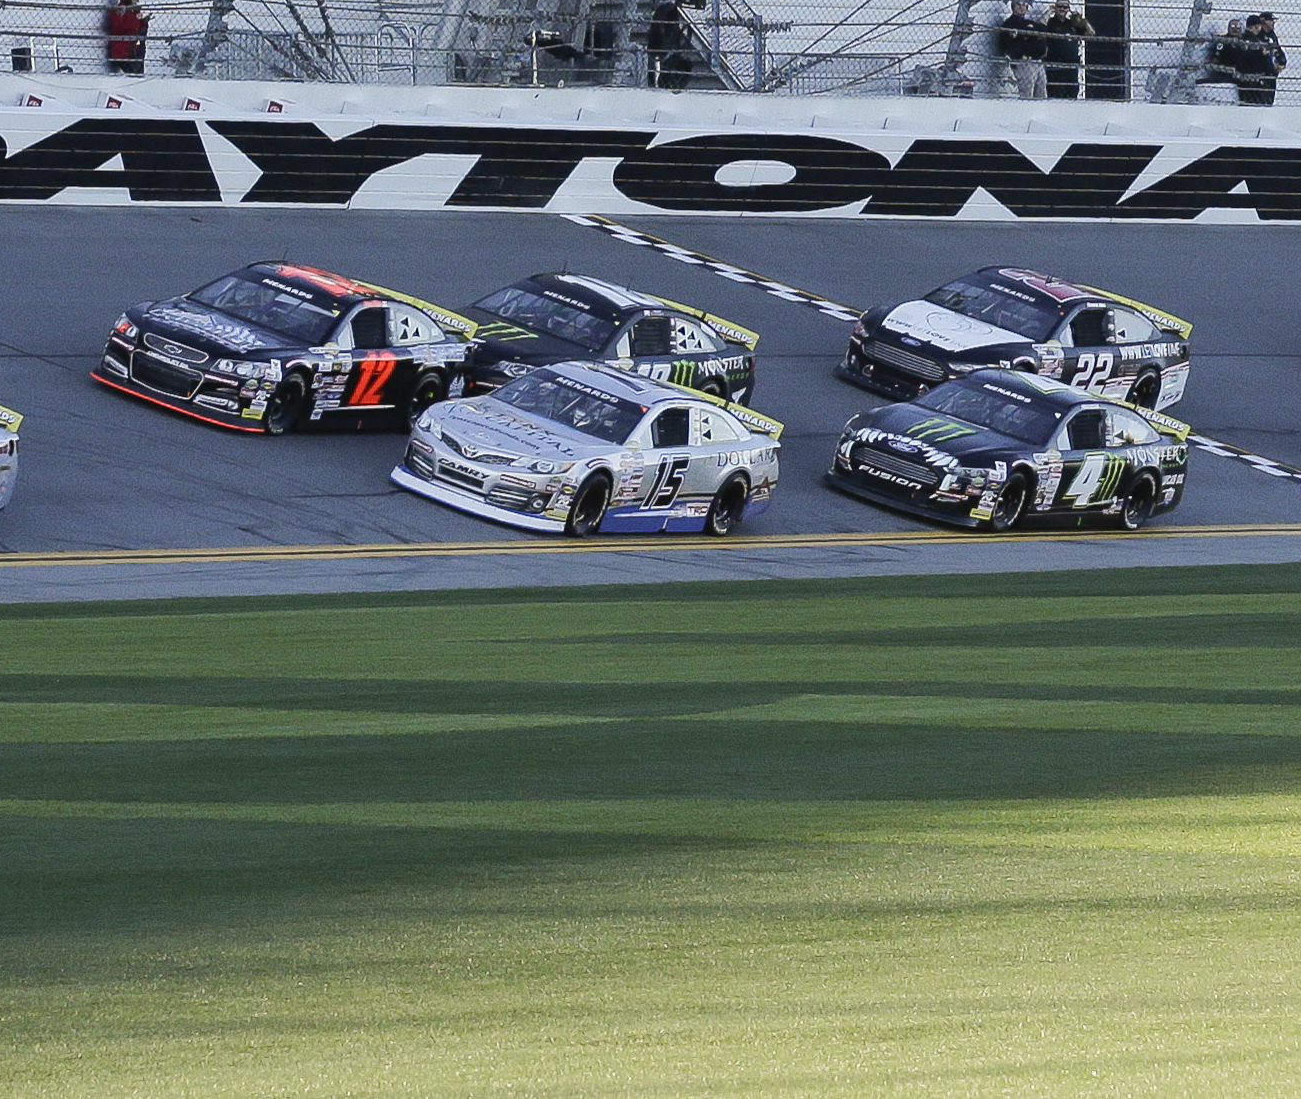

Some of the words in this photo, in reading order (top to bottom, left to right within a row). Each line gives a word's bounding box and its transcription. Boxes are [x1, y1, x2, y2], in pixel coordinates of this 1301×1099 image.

[422, 307, 473, 333] MENARDS
[707, 319, 755, 344] MENARDS
[349, 350, 398, 406] 12
[698, 355, 744, 375] MONSTER
[1071, 352, 1115, 394] 22
[555, 376, 619, 404] MENARDS
[729, 408, 779, 434] MENARDS
[1137, 408, 1186, 432] MENARDS
[437, 457, 491, 480] CAMRY
[640, 452, 691, 510] 15
[858, 464, 923, 491] FUSION
[1064, 453, 1106, 508] 4
